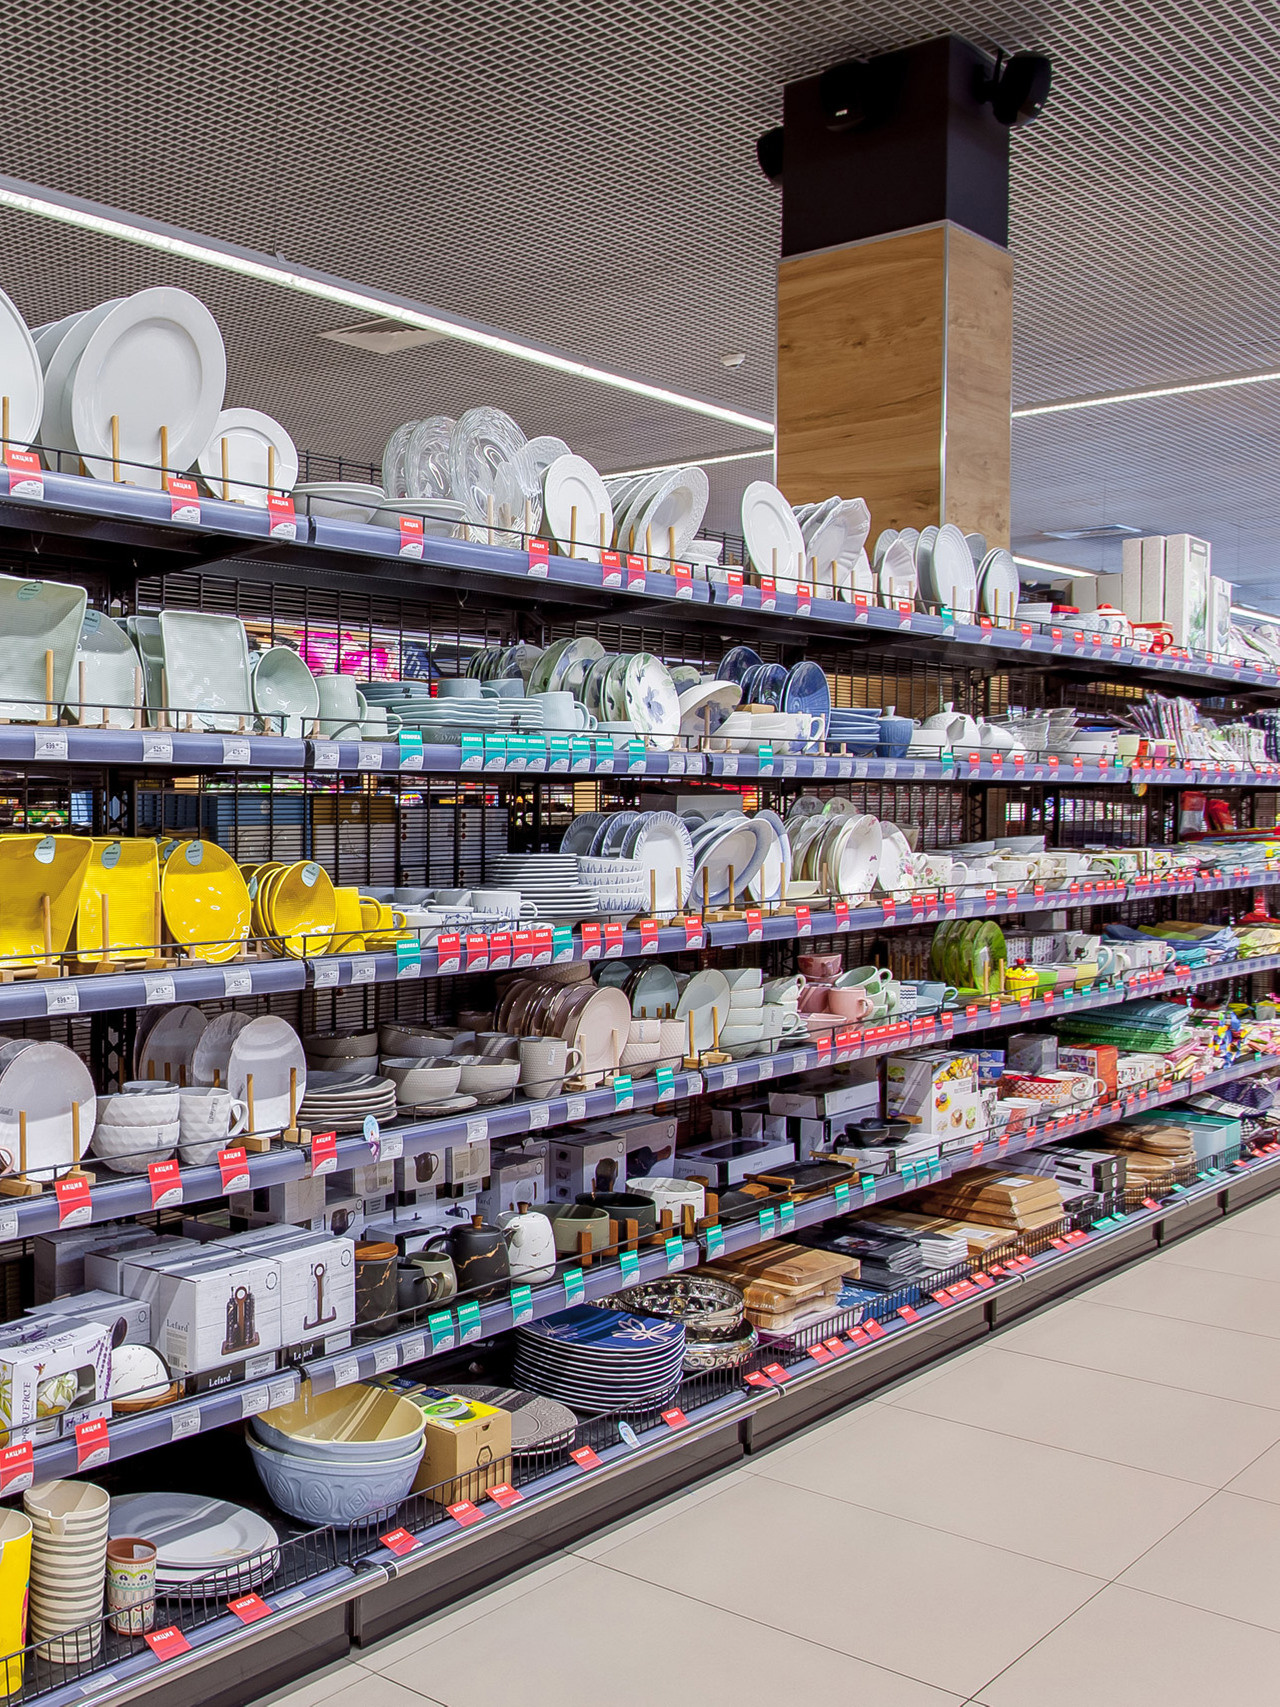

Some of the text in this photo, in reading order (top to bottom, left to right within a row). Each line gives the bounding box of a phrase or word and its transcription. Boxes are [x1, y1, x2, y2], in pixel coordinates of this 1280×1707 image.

[293, 1344, 314, 1361] Leard
[208, 1371, 232, 1387] Lefard
[81, 1423, 102, 1435] АКЦИЯ
[4, 1447, 27, 1460] АКЦИЯ
